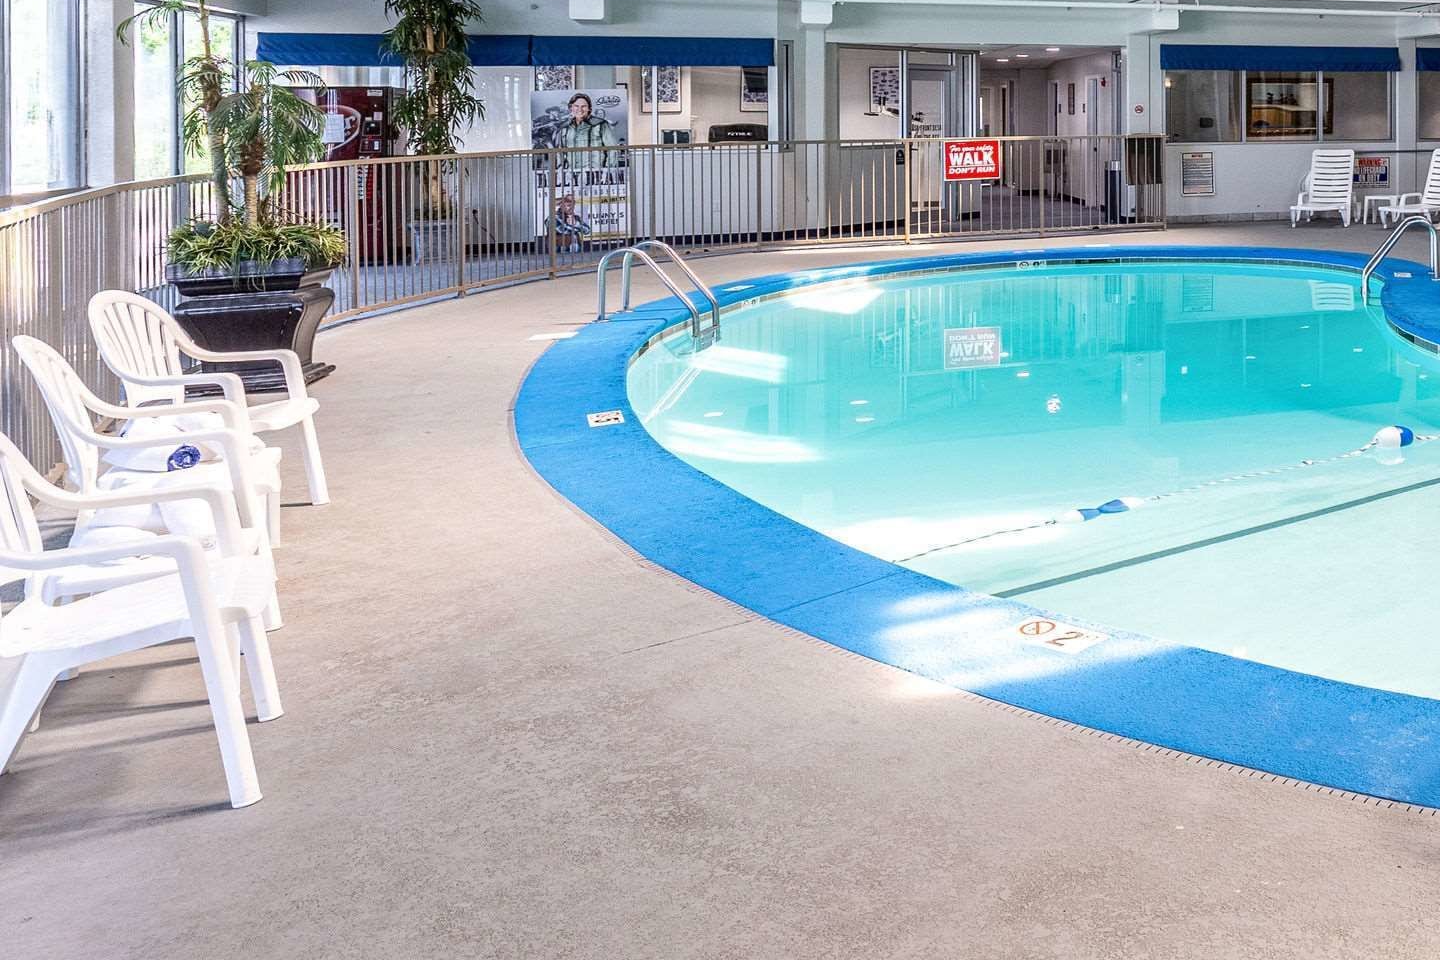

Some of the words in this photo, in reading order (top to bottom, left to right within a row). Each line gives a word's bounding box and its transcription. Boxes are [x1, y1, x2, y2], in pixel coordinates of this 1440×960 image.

[950, 151, 995, 166] WALK
[537, 172, 579, 188] BLLY
[1046, 631, 1084, 646] 2
